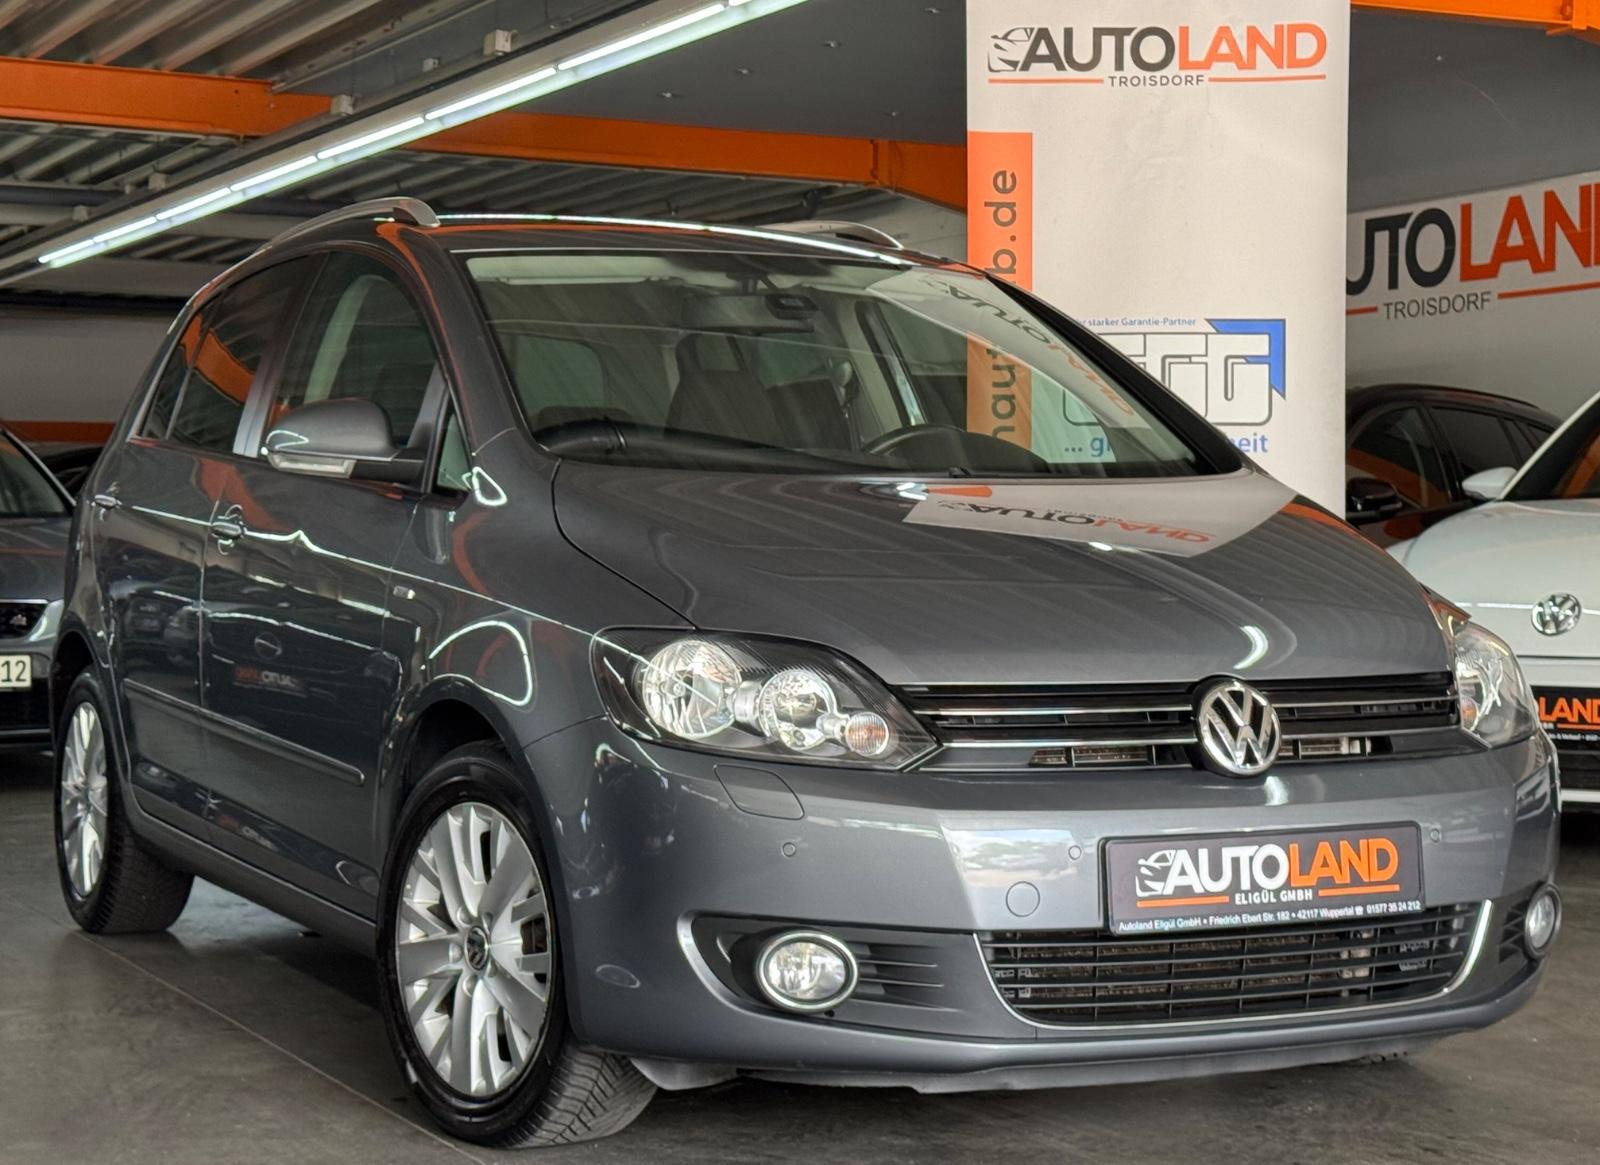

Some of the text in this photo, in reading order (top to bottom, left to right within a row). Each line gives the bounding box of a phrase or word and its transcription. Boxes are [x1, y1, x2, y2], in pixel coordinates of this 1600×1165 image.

[1018, 23, 1327, 72] AUTOLAND
[1109, 74, 1205, 88] TROISDORF
[1346, 183, 1600, 296] UTOLAN
[1383, 291, 1492, 320] TROISDORF
[1088, 318, 1119, 327] starker
[1121, 316, 1196, 327] Garantie-Partner
[1163, 837, 1400, 896] AUTOLAND
[1235, 888, 1313, 906] ELIGÜL GMBH
[1119, 920, 1153, 932] Autoland
[1177, 916, 1202, 928] GmbH
[1209, 913, 1241, 926] Friedrich
[1242, 911, 1262, 923] Ebert
